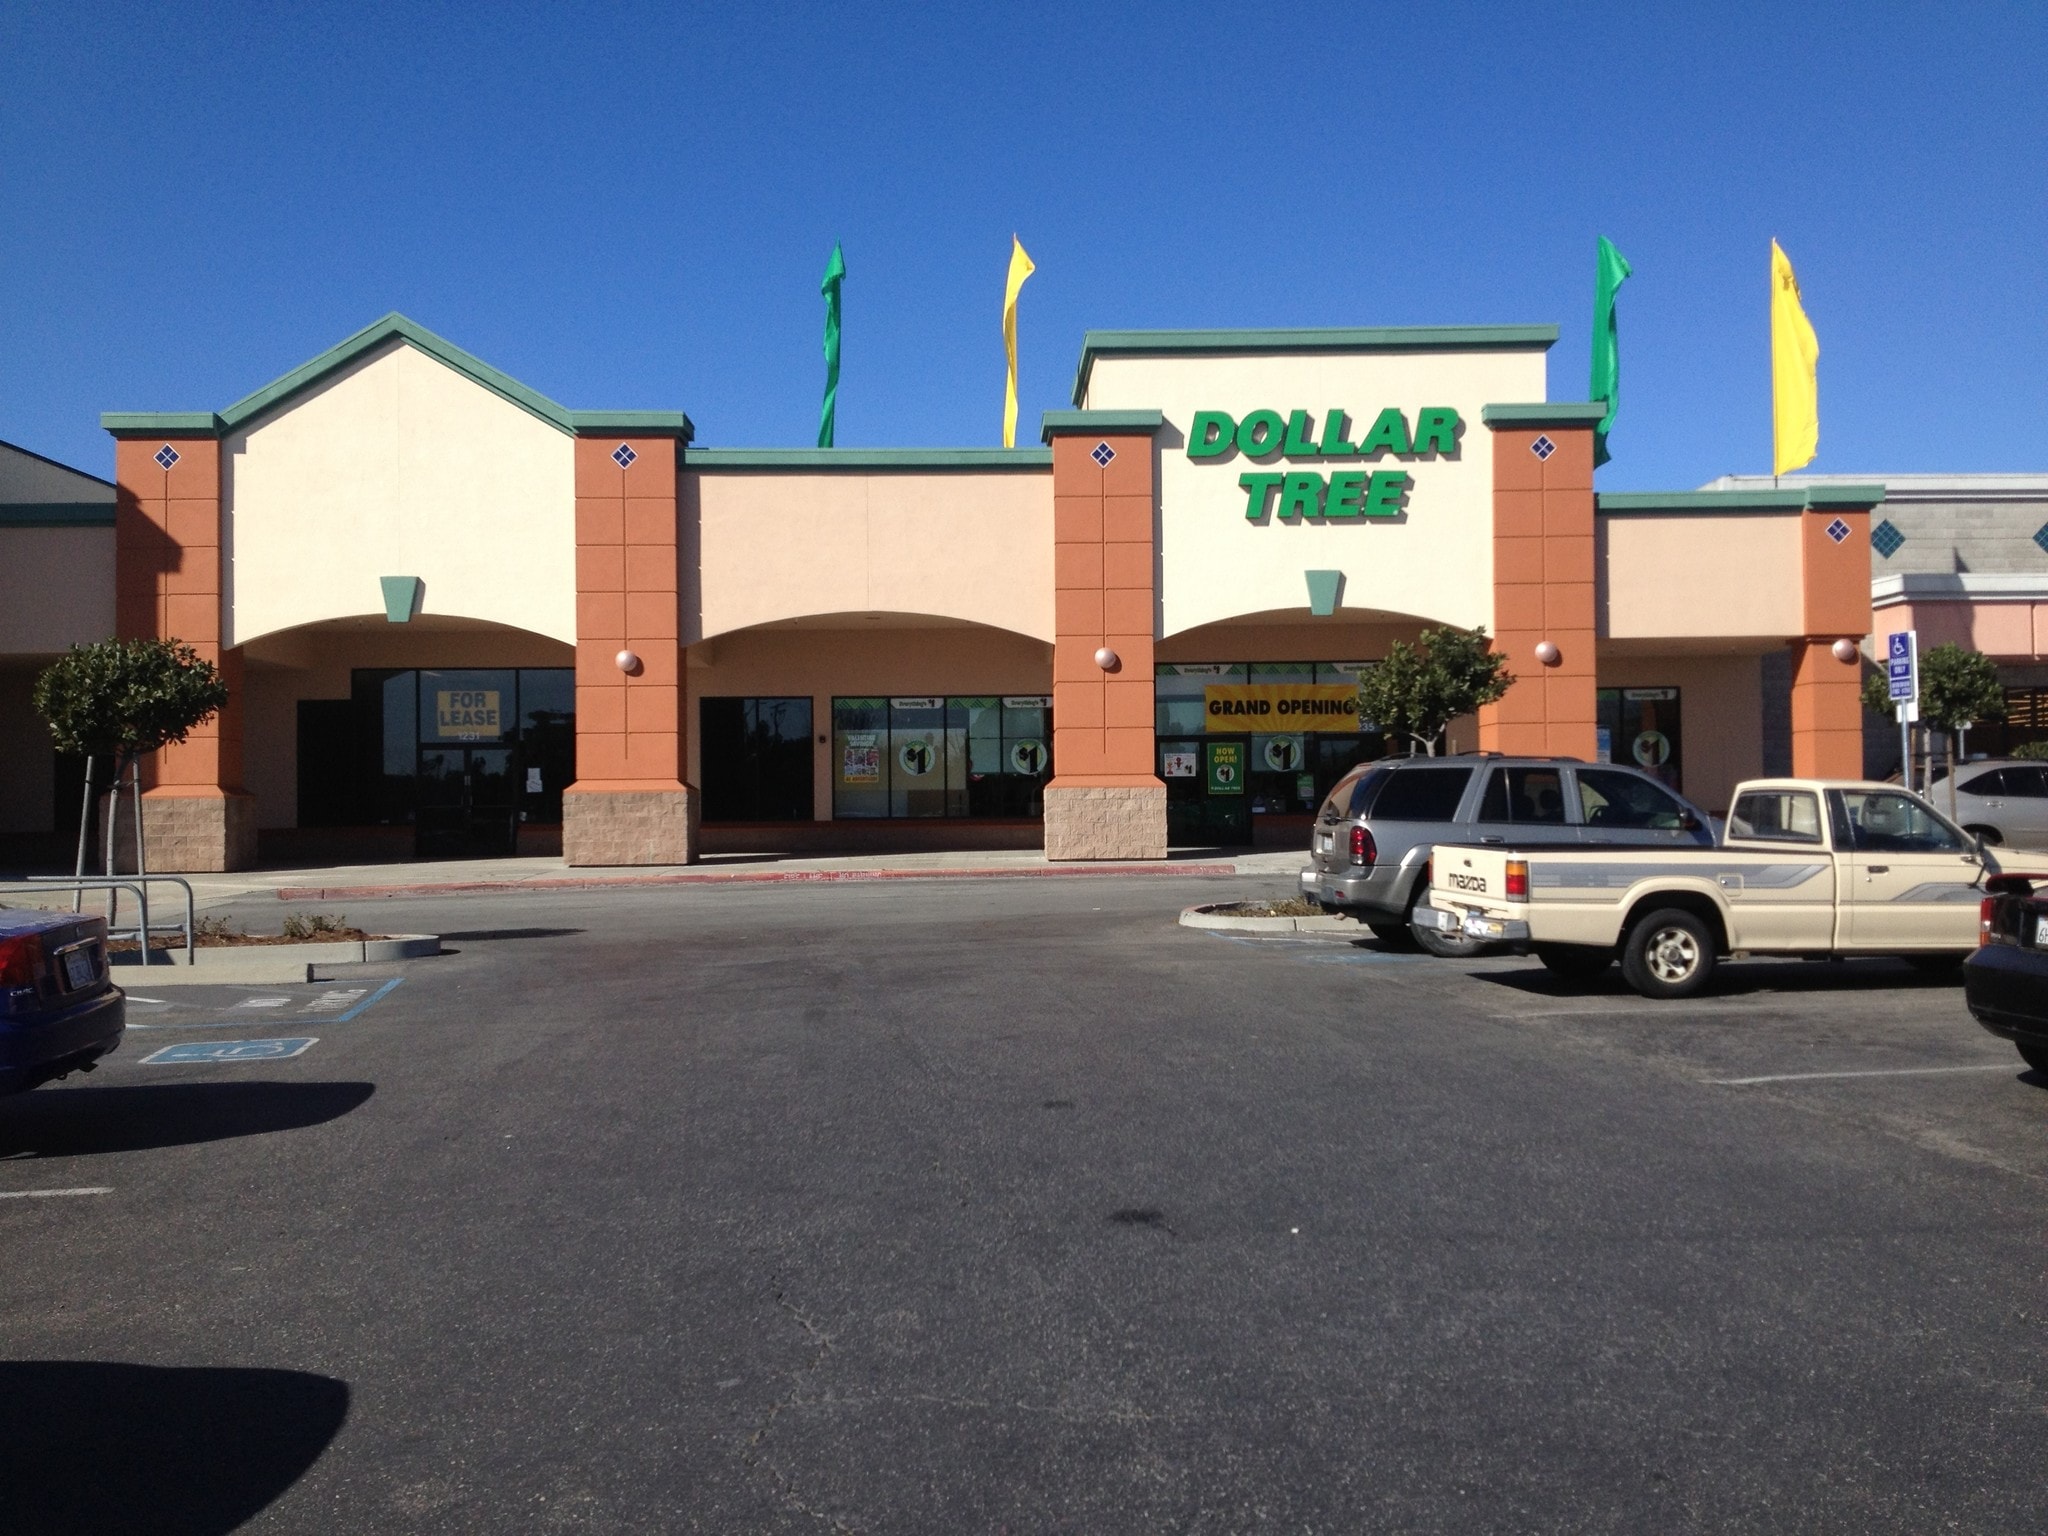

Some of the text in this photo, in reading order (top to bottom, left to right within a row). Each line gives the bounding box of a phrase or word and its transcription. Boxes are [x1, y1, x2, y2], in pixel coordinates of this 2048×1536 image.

[1187, 407, 1460, 457] DOLLAR
[1238, 470, 1408, 518] TREE
[450, 692, 487, 708] FOR
[1209, 699, 1356, 715] GRAND OPENING
[440, 710, 498, 727] LEASE
[1216, 747, 1235, 755] NOW
[1214, 755, 1238, 764] OPEN!
[1449, 873, 1486, 892] mazda
